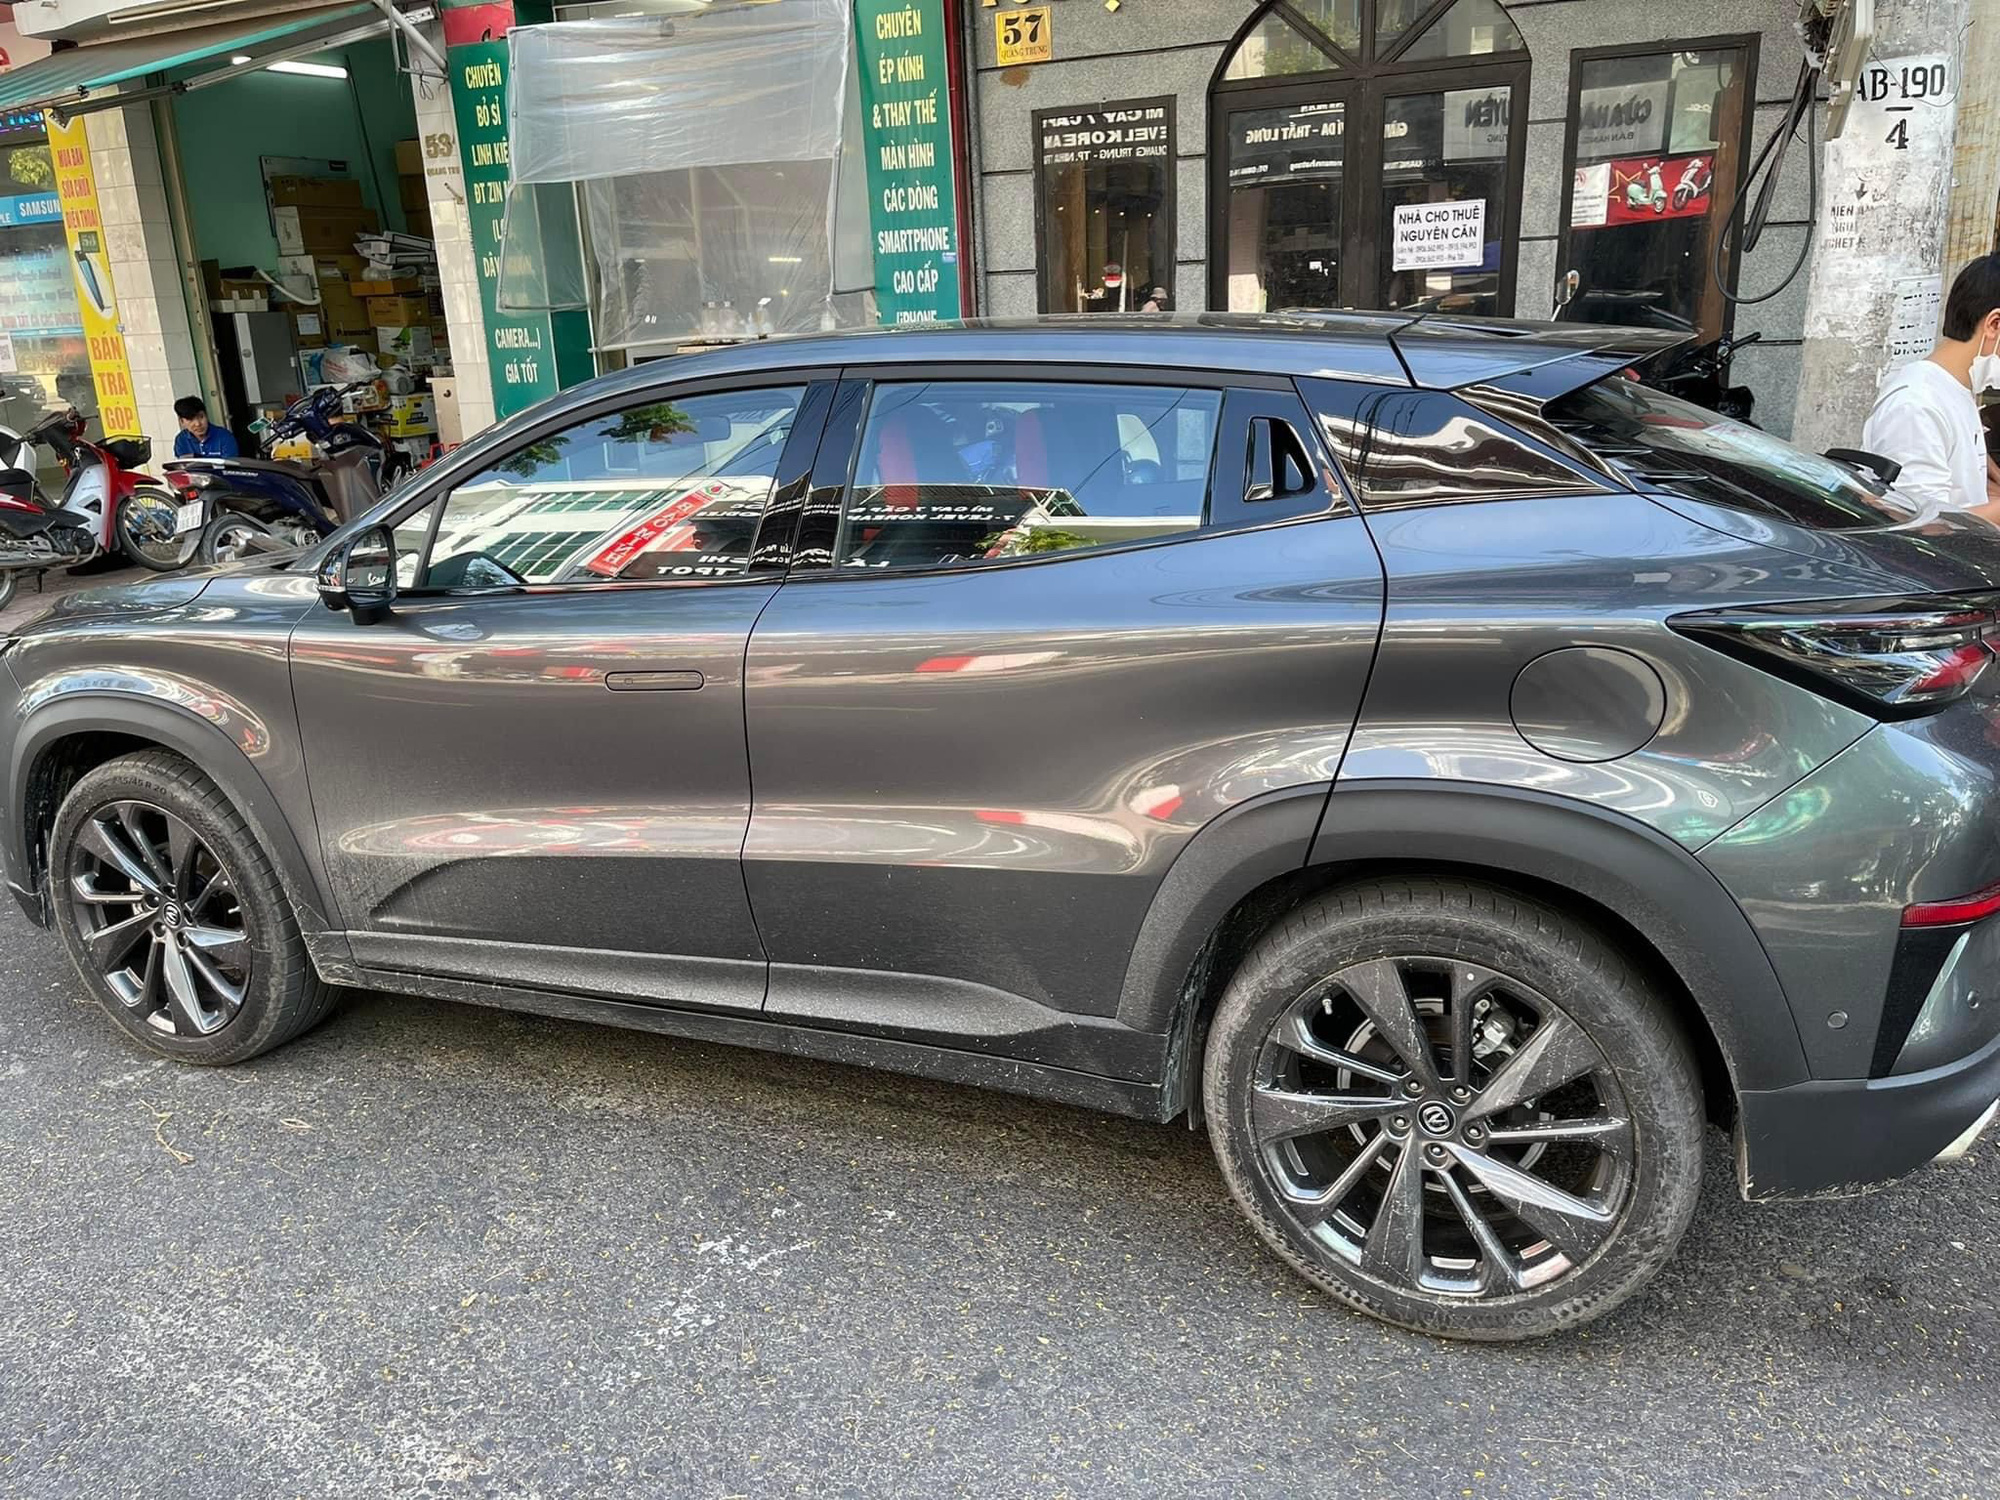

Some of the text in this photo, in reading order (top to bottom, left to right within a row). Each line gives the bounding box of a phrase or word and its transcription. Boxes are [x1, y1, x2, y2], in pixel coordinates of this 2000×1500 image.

[875, 3, 922, 40] CHUYÊN
[1003, 14, 1043, 45] 57
[465, 57, 502, 89] CHUYÊN
[878, 49, 925, 85] ÉP KÍNH
[475, 95, 490, 127] BỎ
[872, 87, 938, 130] & THAY THẾ
[424, 133, 454, 159] 53
[1884, 118, 1910, 150] 4
[471, 136, 509, 168] LINH KIỆ
[880, 137, 935, 170] MÀN HÌNH
[19, 199, 61, 217] SAMSUN
[883, 179, 939, 212] CÁC DÒNG
[1399, 205, 1480, 225] NHÀ CHO THUÊ
[877, 226, 950, 254] SMARTPHONE
[1400, 224, 1477, 242] NGUYÊN CĂN
[893, 260, 939, 294] CAO CẤP
[89, 330, 122, 361] BÁN
[97, 364, 128, 396] TRẢ
[505, 354, 538, 384] GIÁ TỐT
[104, 401, 134, 430] GÓP
